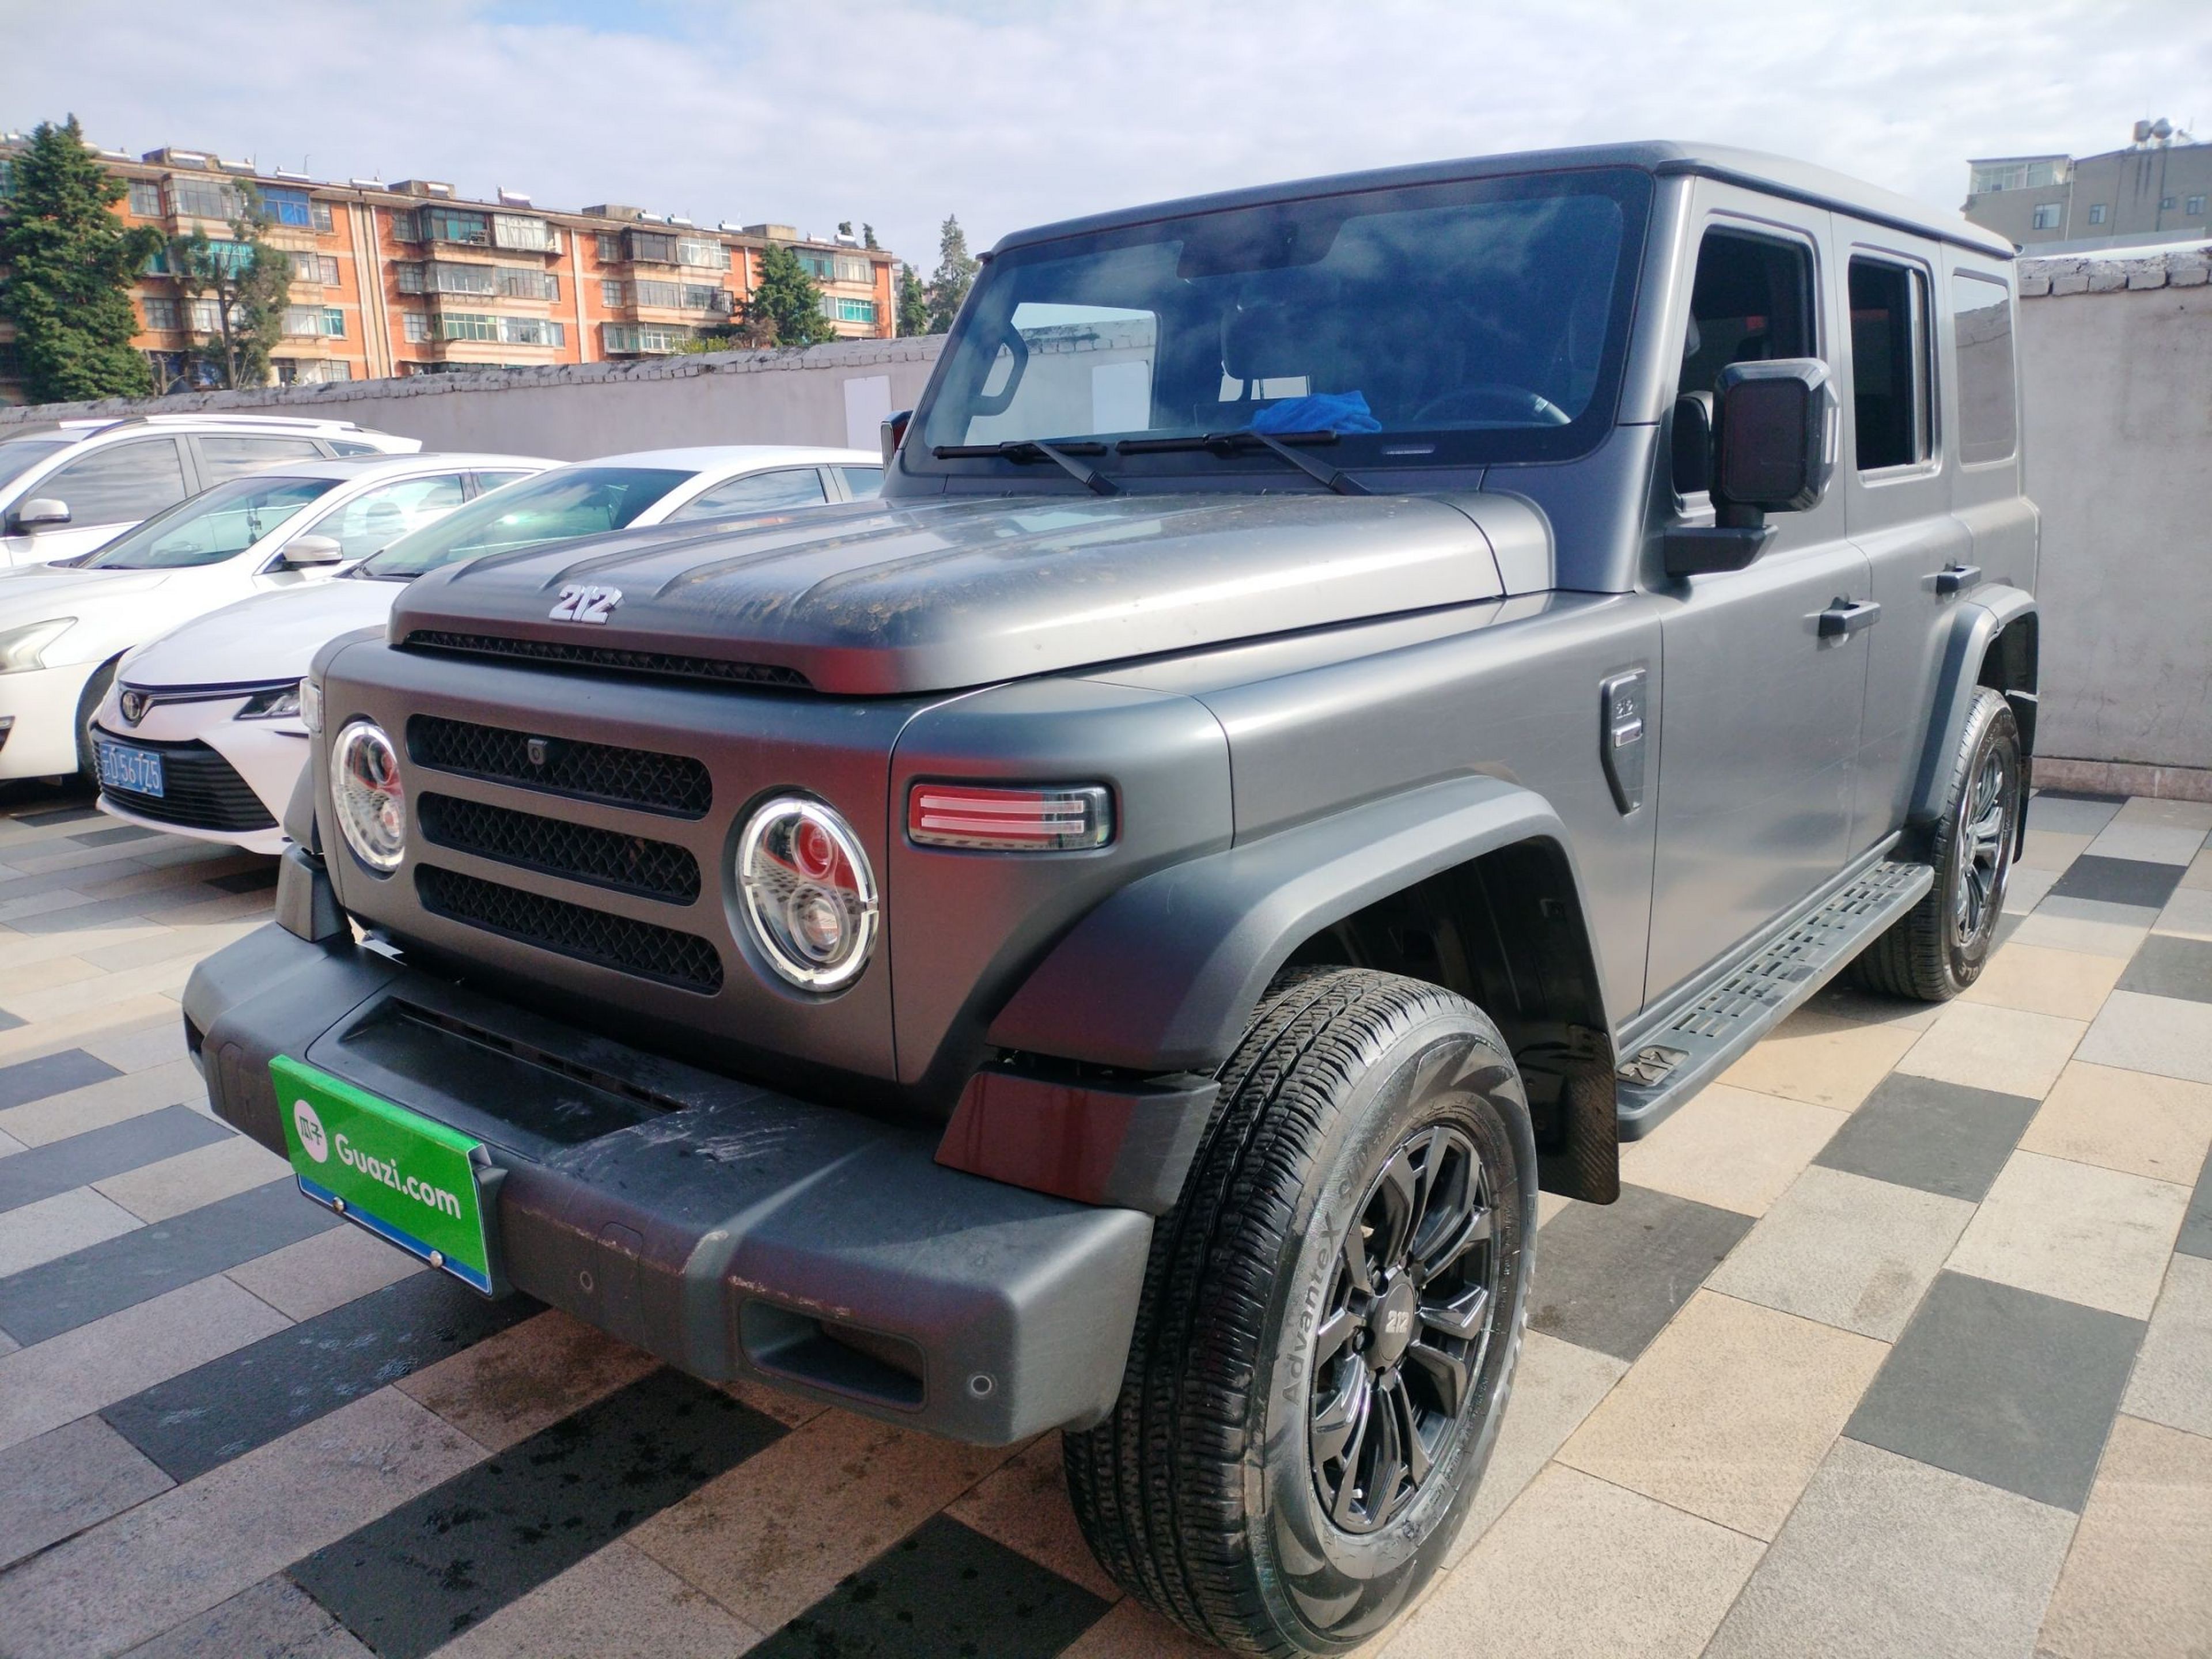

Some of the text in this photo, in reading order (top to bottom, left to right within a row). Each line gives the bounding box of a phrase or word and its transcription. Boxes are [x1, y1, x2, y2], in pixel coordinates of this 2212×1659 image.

[549, 584, 623, 624] 212
[298, 1115, 323, 1146] 瓜子
[334, 1133, 462, 1220] Guazi.com
[1282, 1211, 1342, 1406] AdvanteX
[1385, 1310, 1410, 1333] 212
